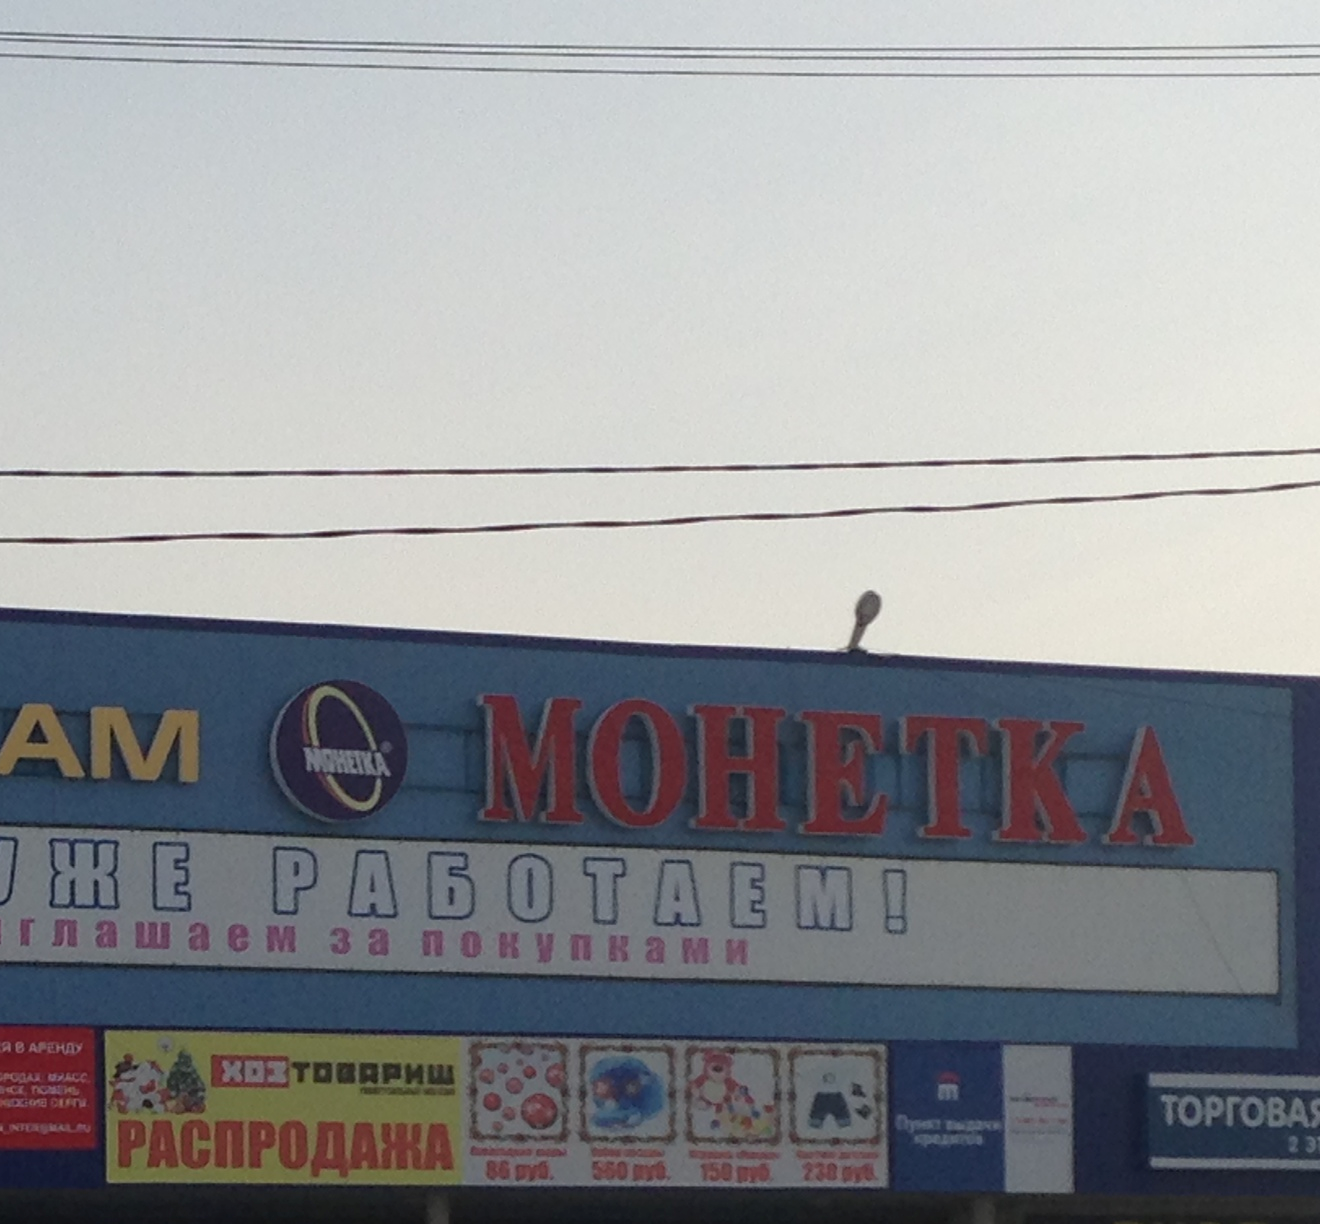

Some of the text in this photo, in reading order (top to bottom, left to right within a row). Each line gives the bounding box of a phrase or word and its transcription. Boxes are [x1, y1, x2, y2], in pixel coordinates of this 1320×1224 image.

[302, 746, 392, 779] МОНЕТКА
[477, 694, 1196, 846] МОНЕТКА
[272, 846, 908, 935] РАБОТАЕМ!
[329, 925, 390, 958] за
[421, 927, 750, 966] покупками
[14, 1041, 25, 1054] В
[28, 1042, 83, 1056] АРЕНДУ
[894, 1113, 942, 1134] Пункт
[117, 1119, 455, 1178] РАСПРОДАЖА
[1288, 1135, 1300, 1154] 2
